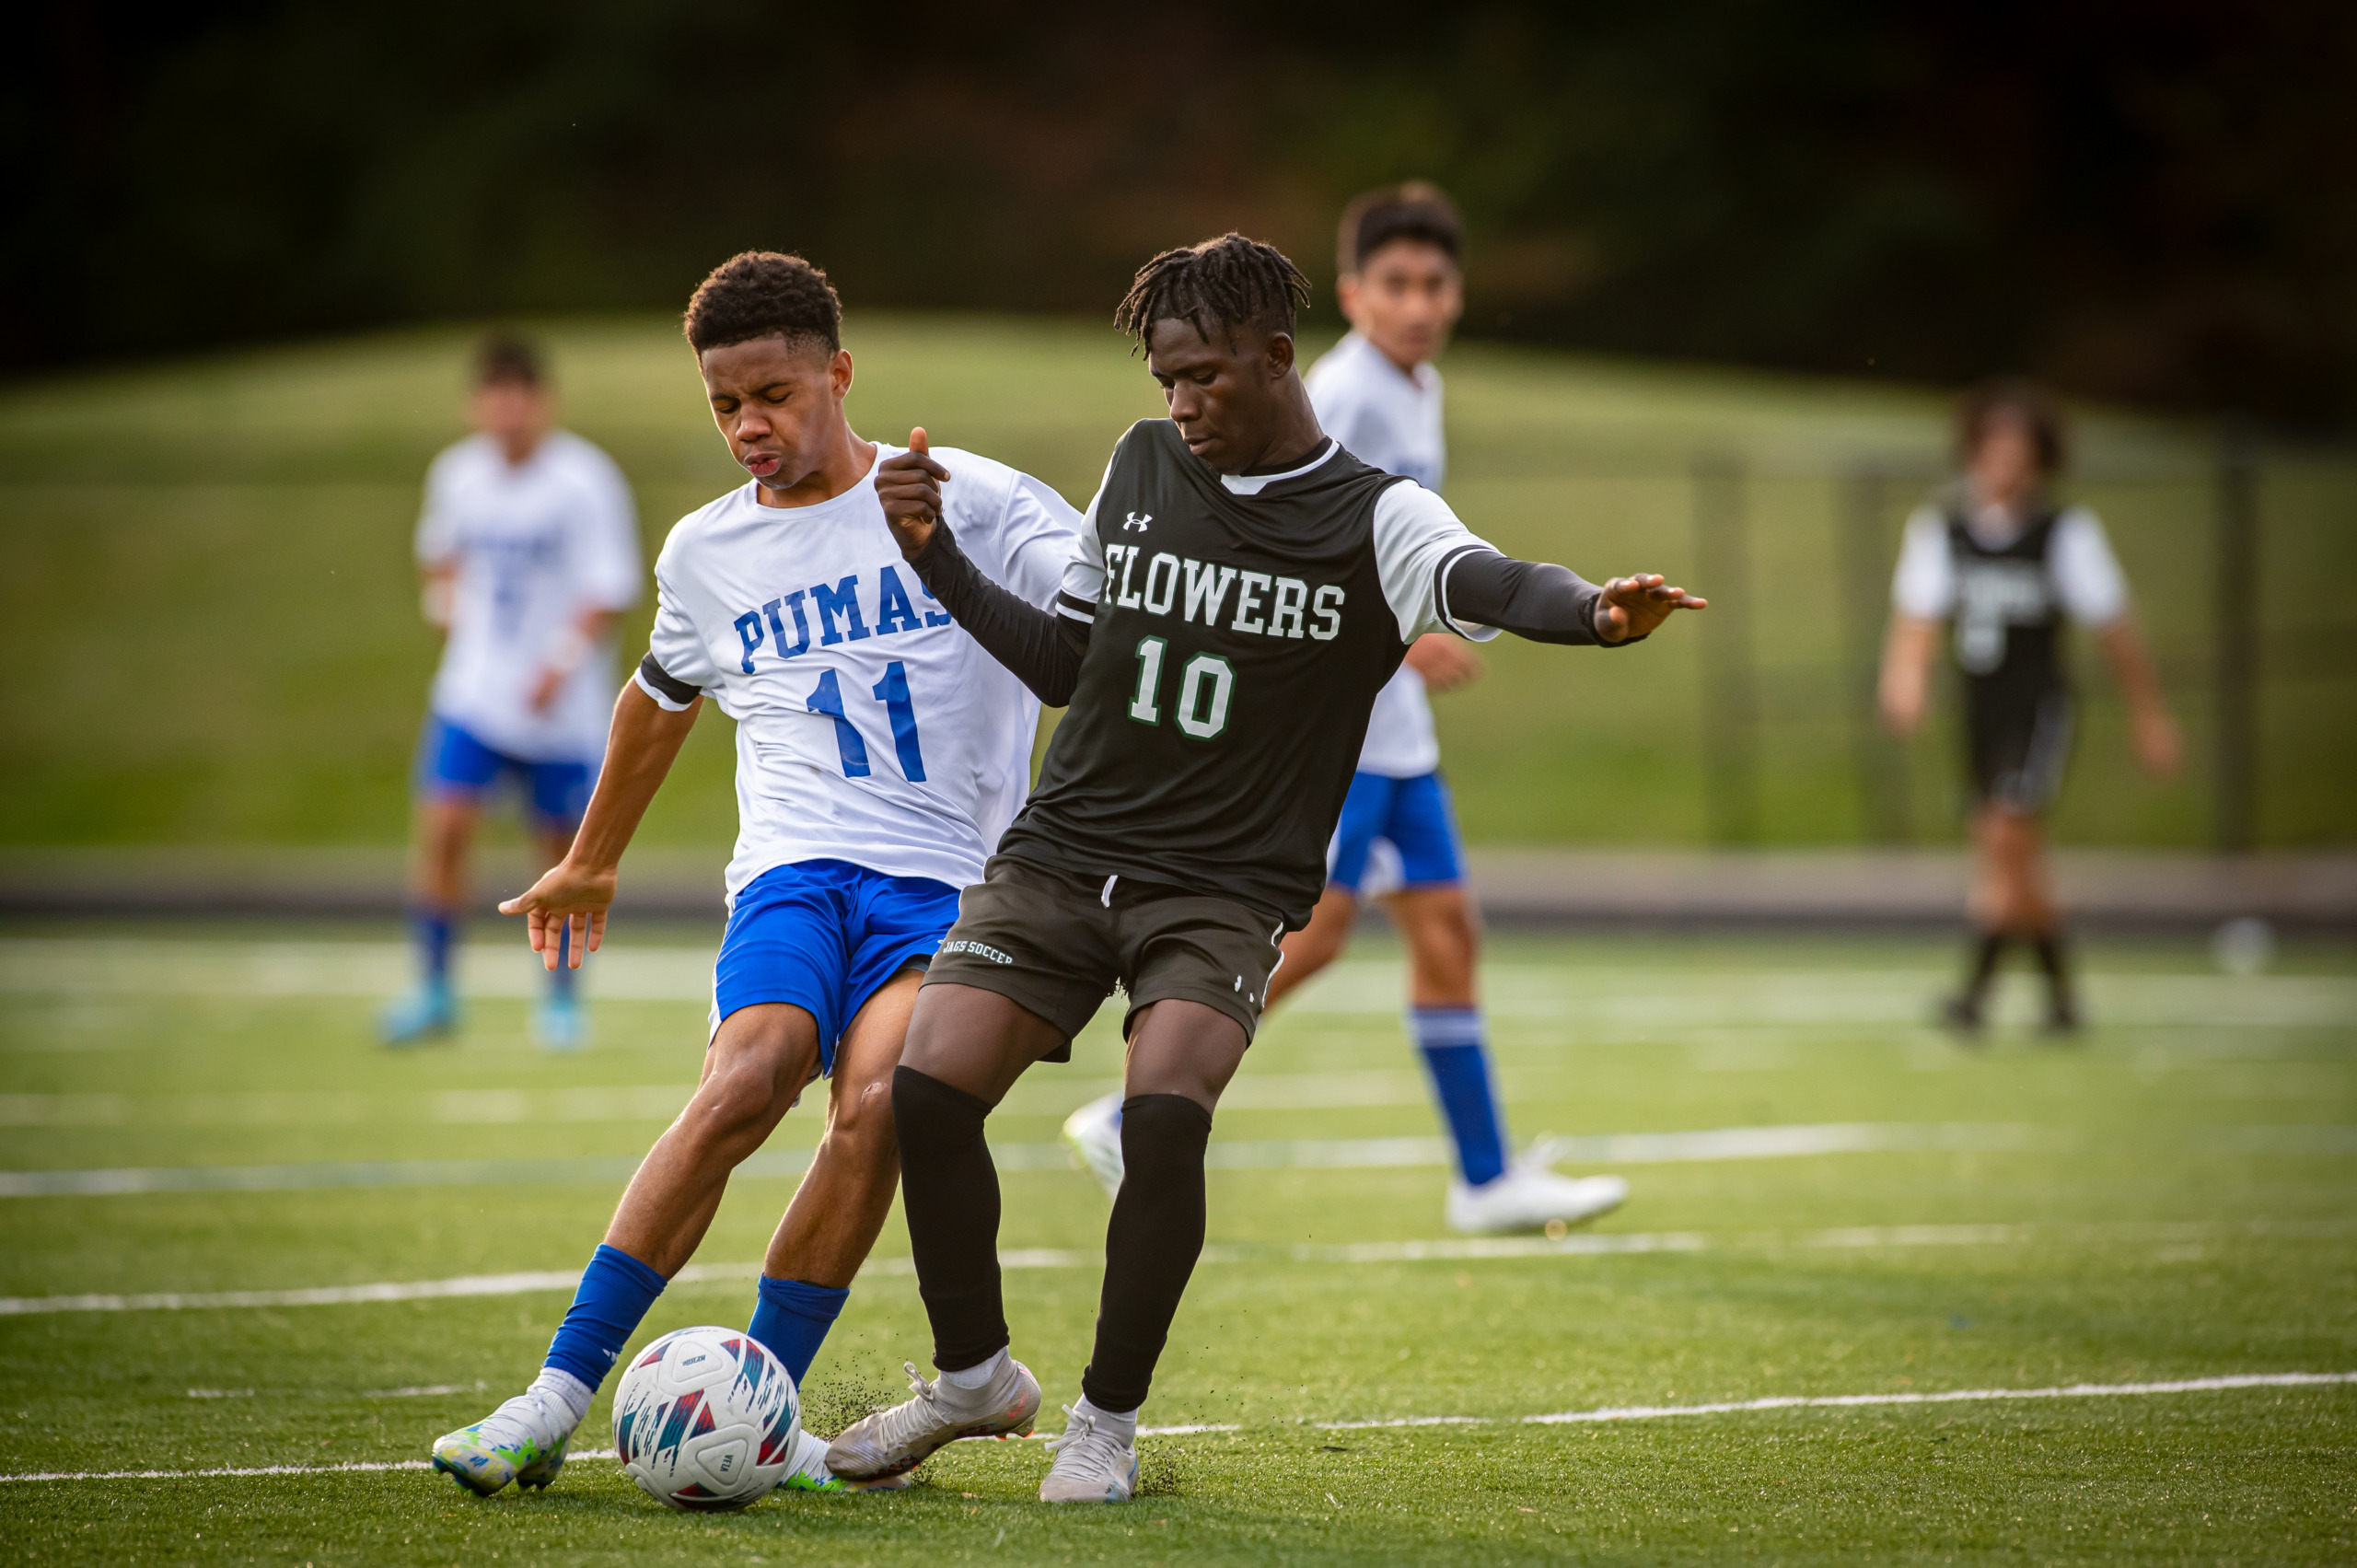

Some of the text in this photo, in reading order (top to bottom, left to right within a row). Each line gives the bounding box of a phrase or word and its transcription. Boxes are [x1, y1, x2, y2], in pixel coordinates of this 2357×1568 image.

[1104, 543, 1346, 641] FLOWERS
[807, 660, 927, 783] 11
[1128, 634, 1237, 742] 10
[943, 940, 1013, 964] JAGS SOCCER
